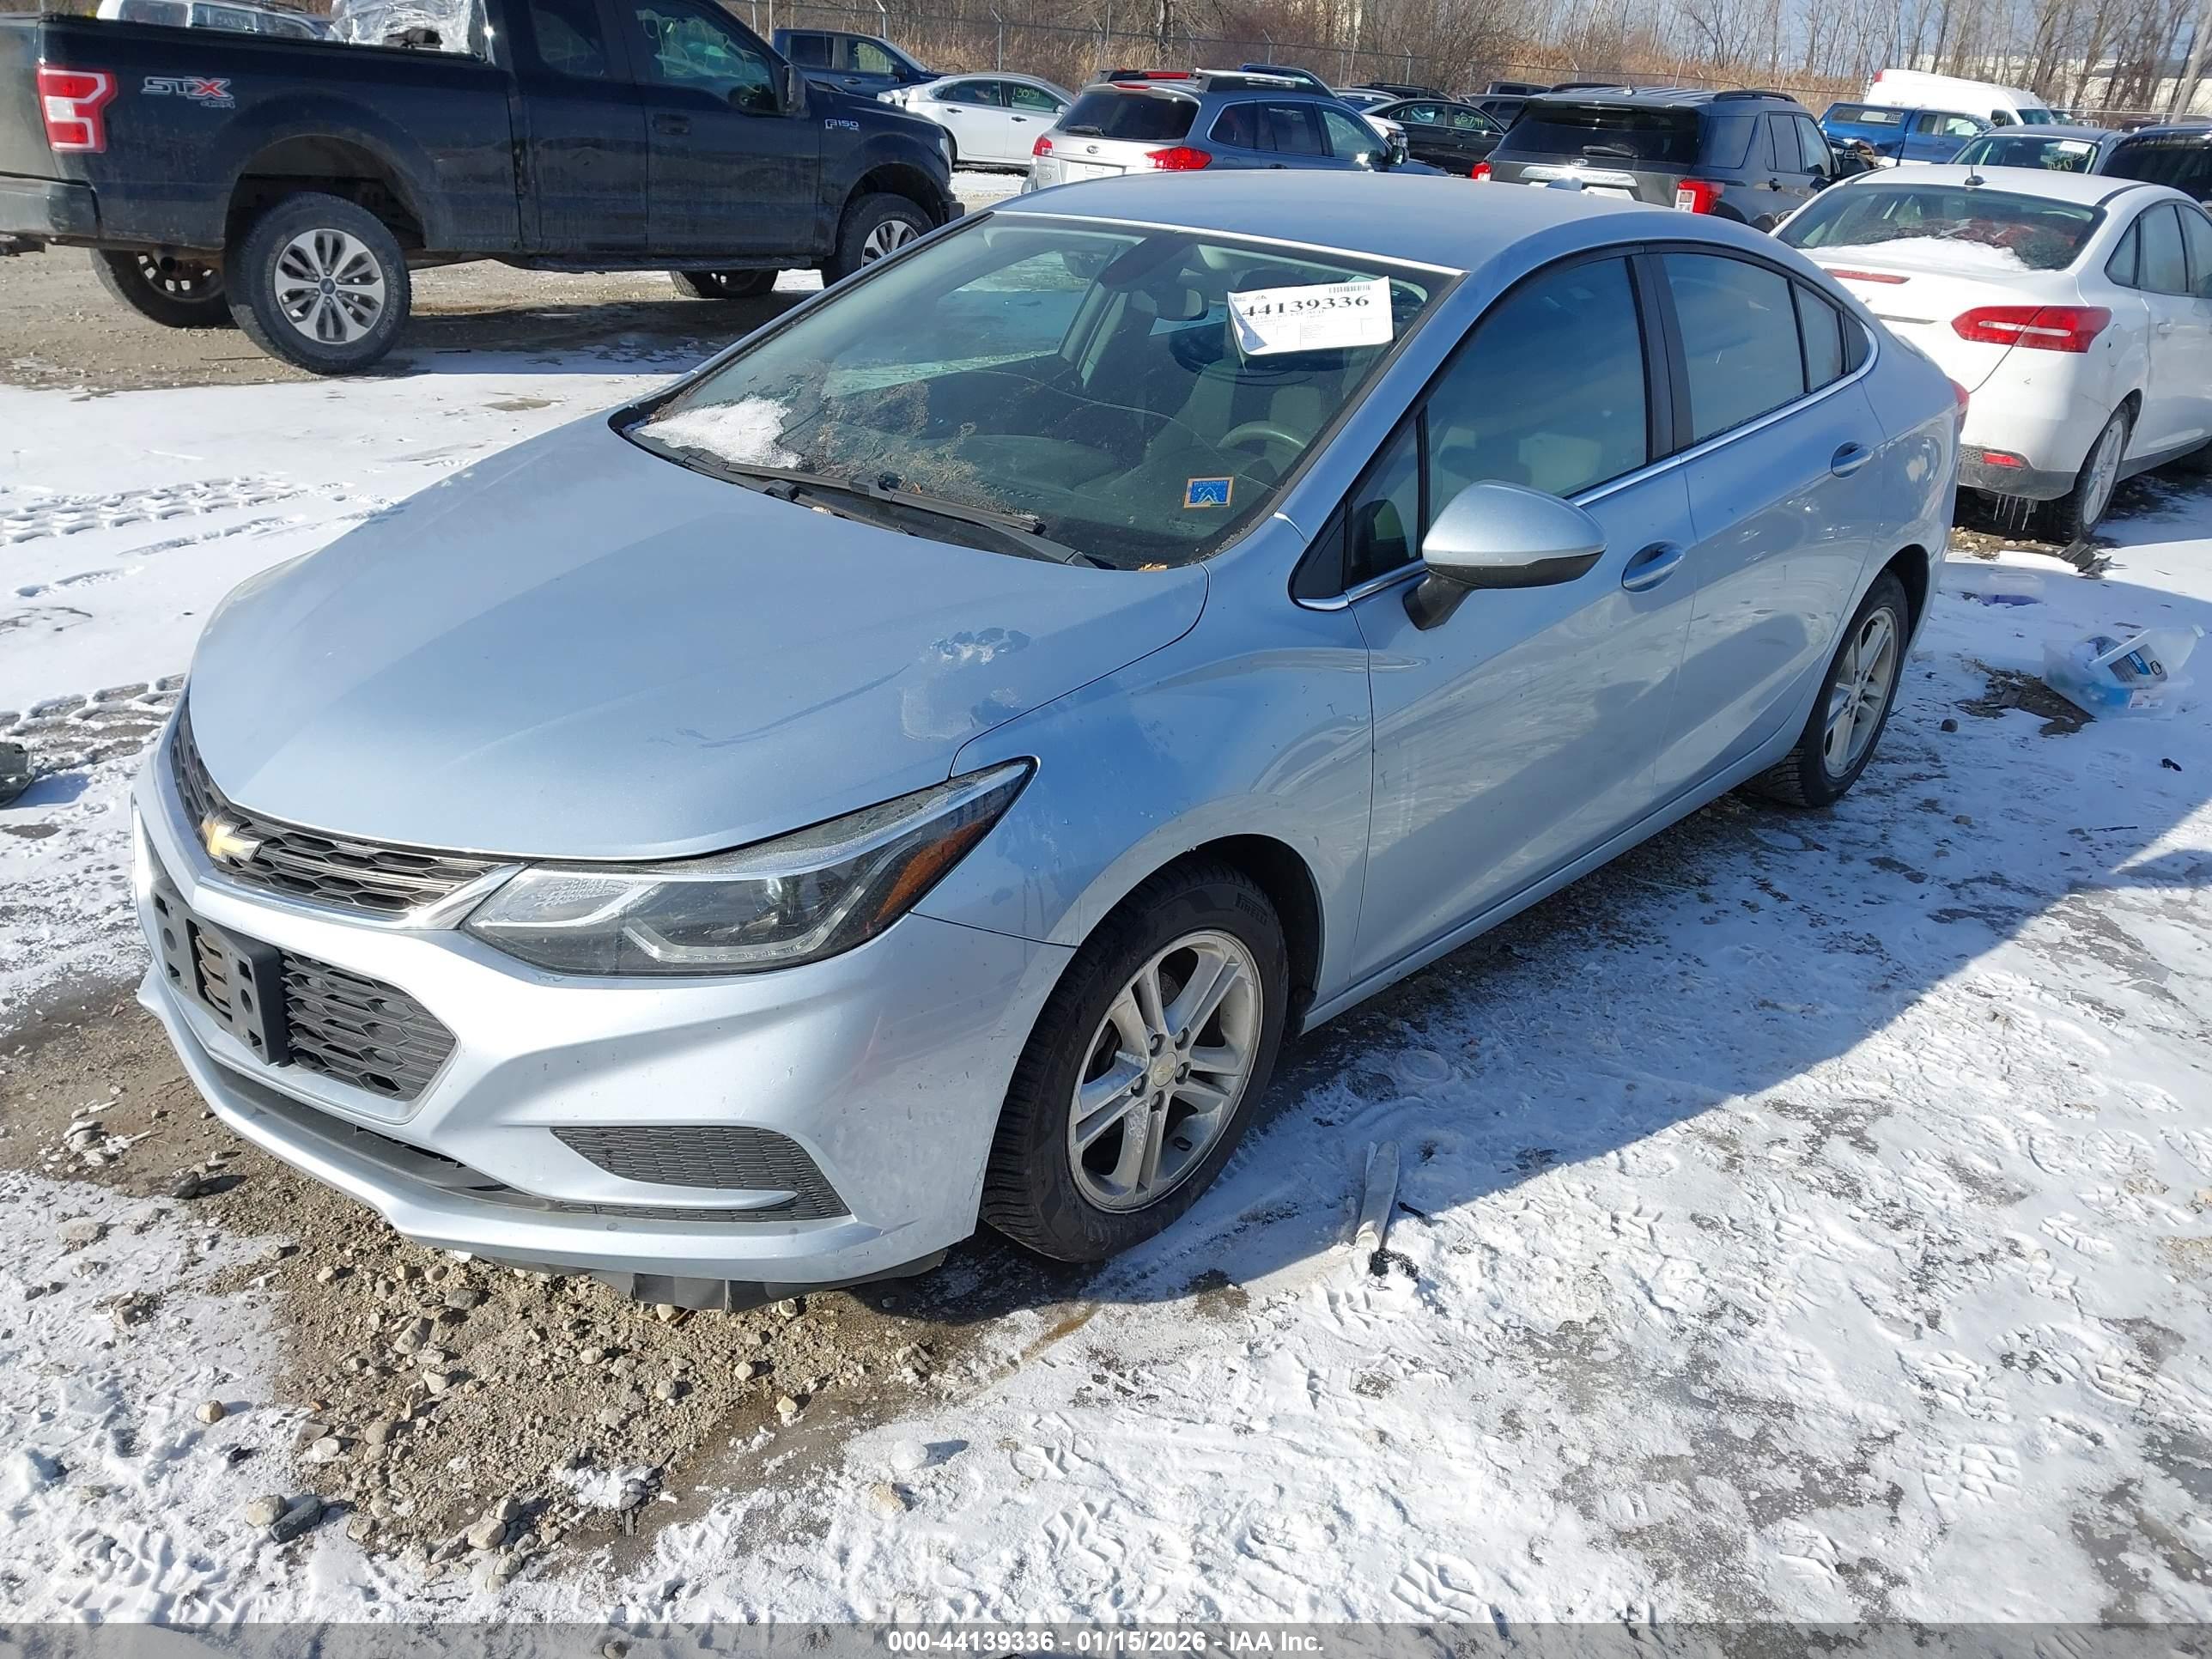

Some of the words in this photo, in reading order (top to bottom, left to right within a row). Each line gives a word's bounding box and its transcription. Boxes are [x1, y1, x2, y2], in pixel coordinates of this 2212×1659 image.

[140, 76, 234, 100] STX
[824, 118, 860, 129] F150
[1453, 114, 1485, 128] 30794
[1242, 295, 1370, 317] 44139336
